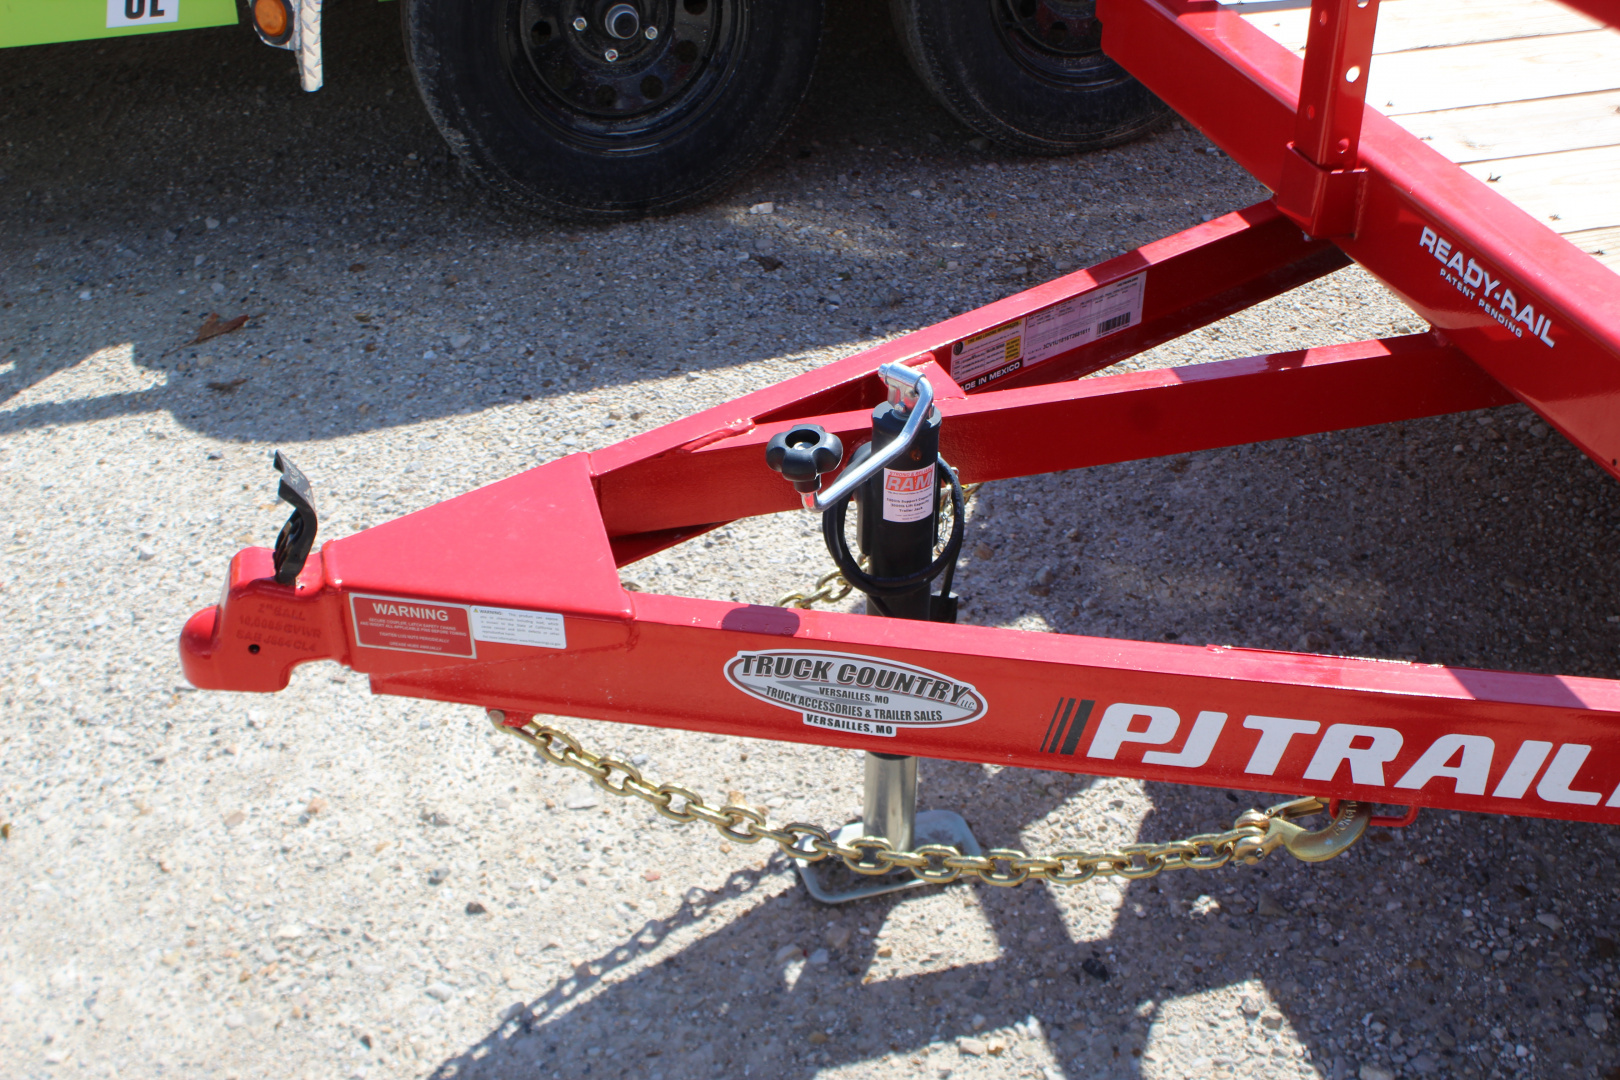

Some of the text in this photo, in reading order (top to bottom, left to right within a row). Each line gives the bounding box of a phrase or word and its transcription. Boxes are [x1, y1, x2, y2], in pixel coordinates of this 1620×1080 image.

[1440, 268, 1523, 338] PATENT PENDING
[961, 362, 1020, 391] ADE IN MEXICO
[887, 472, 932, 491] RAM
[372, 603, 449, 621] WARNING
[741, 655, 975, 709] TRUCK COUNTRY LLC
[766, 685, 943, 721] TRUCK ACCESSORIES & TRAILER SALES
[875, 695, 889, 704] MO
[876, 725, 893, 734] MO
[1087, 703, 1620, 807] PJ TRAIL
